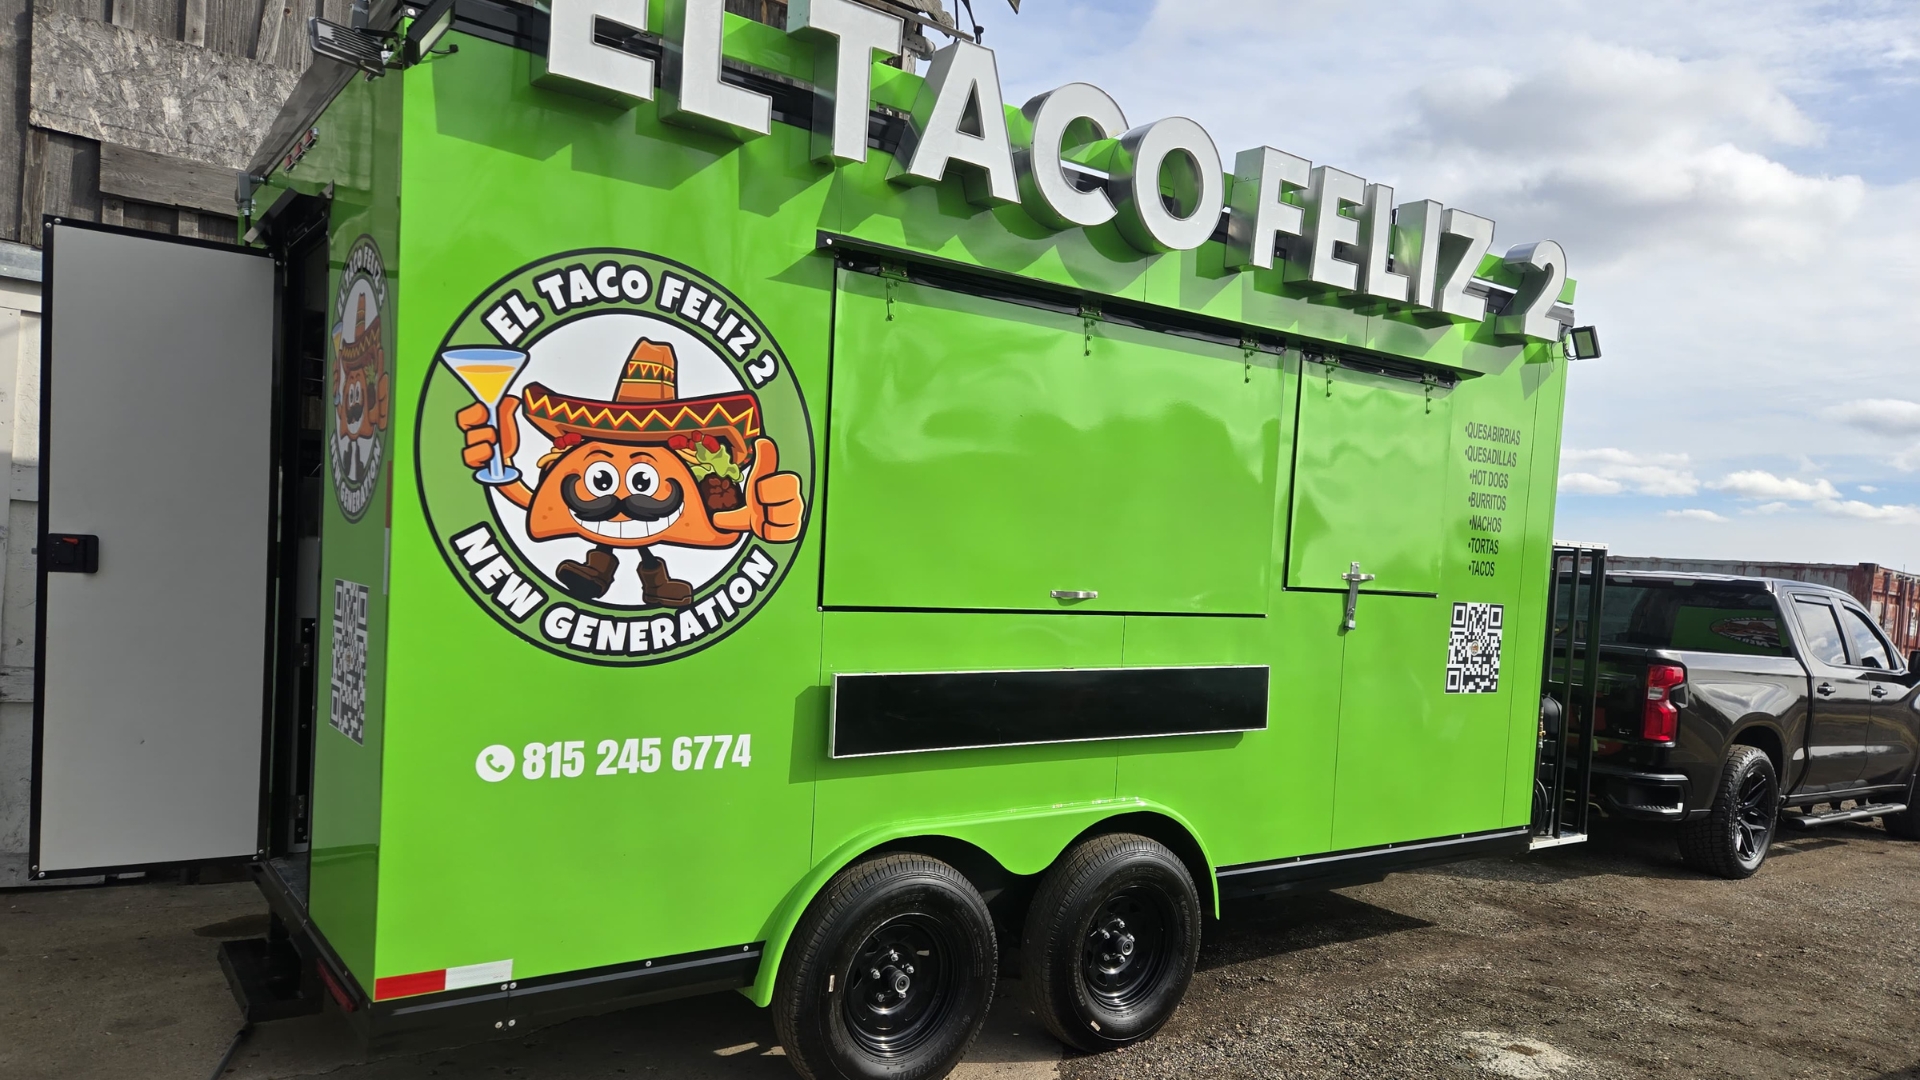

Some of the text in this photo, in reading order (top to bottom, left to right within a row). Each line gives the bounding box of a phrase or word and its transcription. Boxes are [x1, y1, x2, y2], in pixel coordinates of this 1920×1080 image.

[546, 0, 1567, 342] EL TACO FELIZ 2
[363, 246, 381, 289] FELIZ
[486, 265, 776, 385] EL TACO FELIZ 2
[1467, 421, 1521, 446] QUESABIRRIAS
[1467, 445, 1517, 467] QUESADILLAS
[1471, 469, 1509, 489] HOT DOGS
[1470, 492, 1507, 511] BURRITOS
[1471, 515, 1502, 533] NACHOS
[1471, 537, 1499, 555] TORTAS
[1471, 560, 1495, 577] TACOS
[454, 526, 774, 651] NEW GENERATION
[522, 734, 751, 780] 815 245 6774
